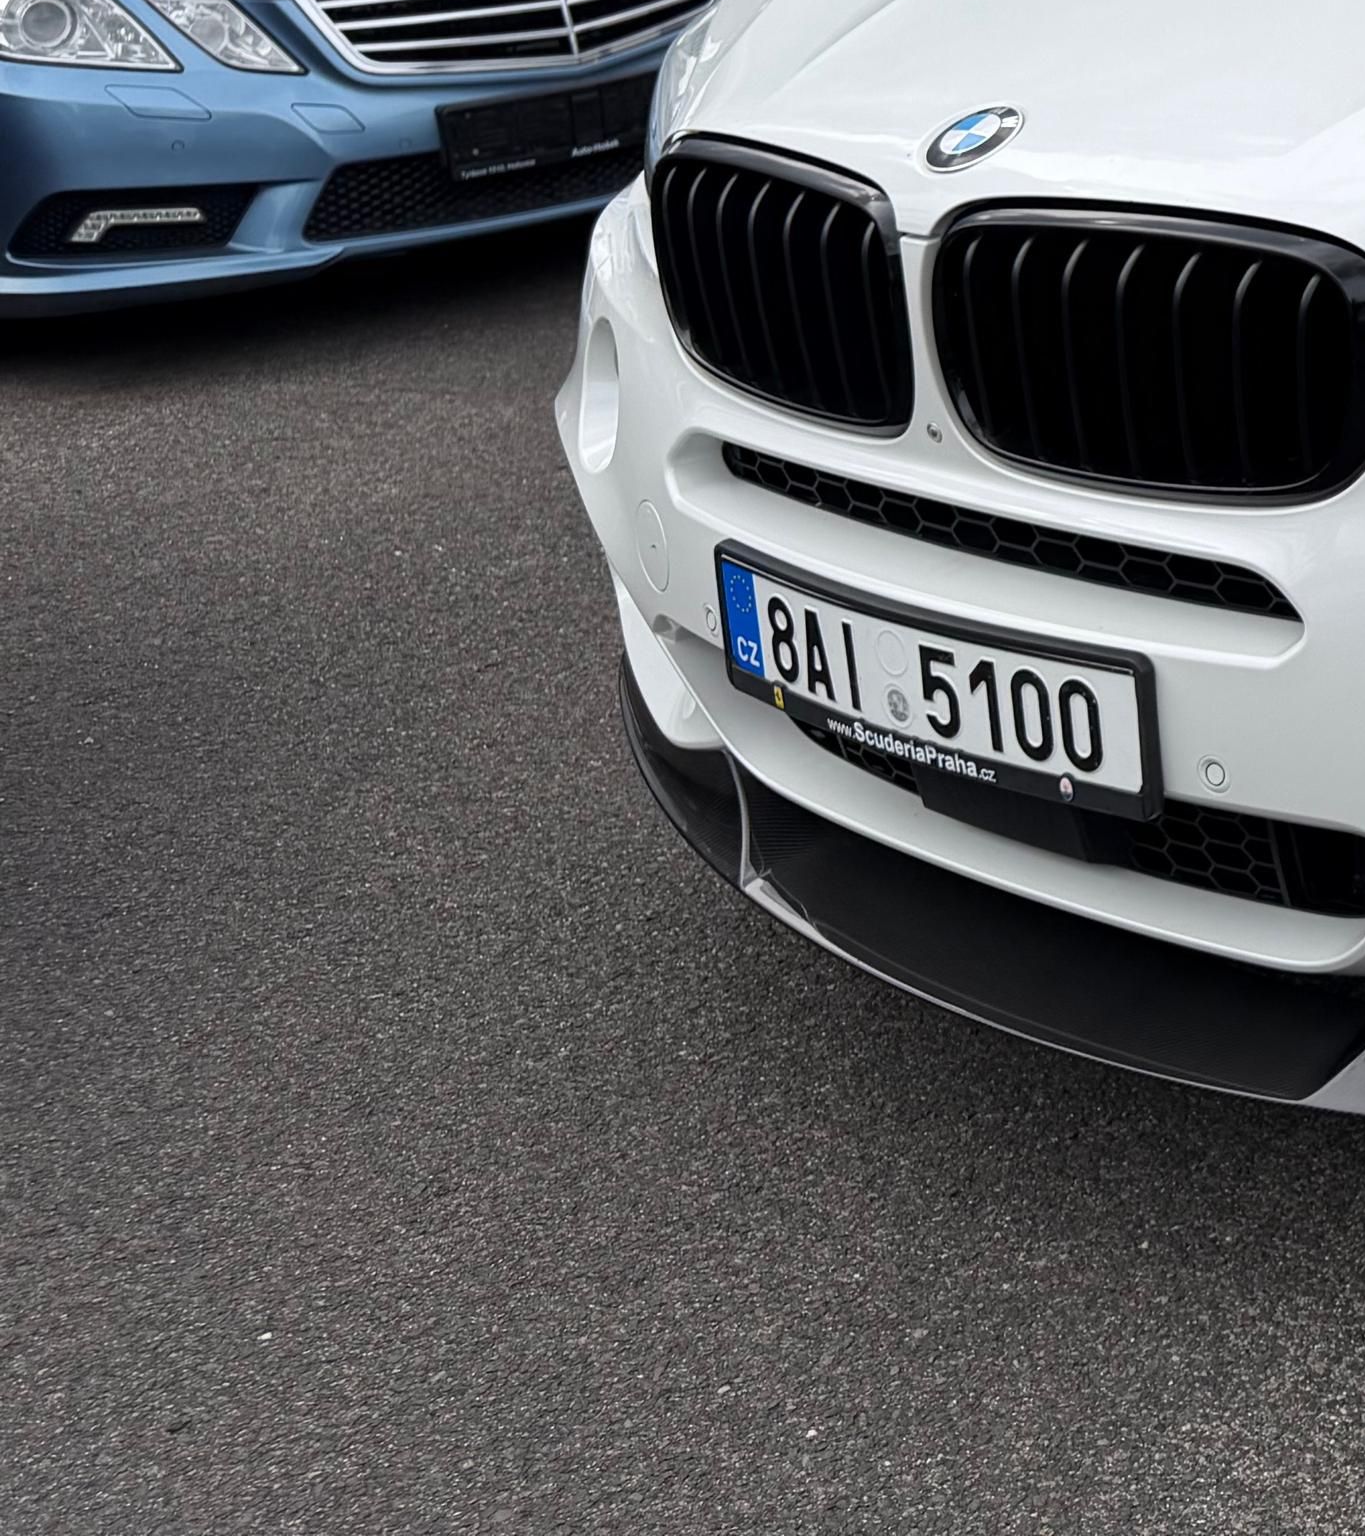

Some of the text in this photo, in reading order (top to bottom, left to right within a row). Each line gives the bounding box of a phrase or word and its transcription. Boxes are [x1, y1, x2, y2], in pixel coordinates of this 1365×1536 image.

[736, 635, 760, 668] CZ
[918, 642, 1104, 772] 5100
[826, 717, 998, 783] www.ScuderiaPraha.cz
